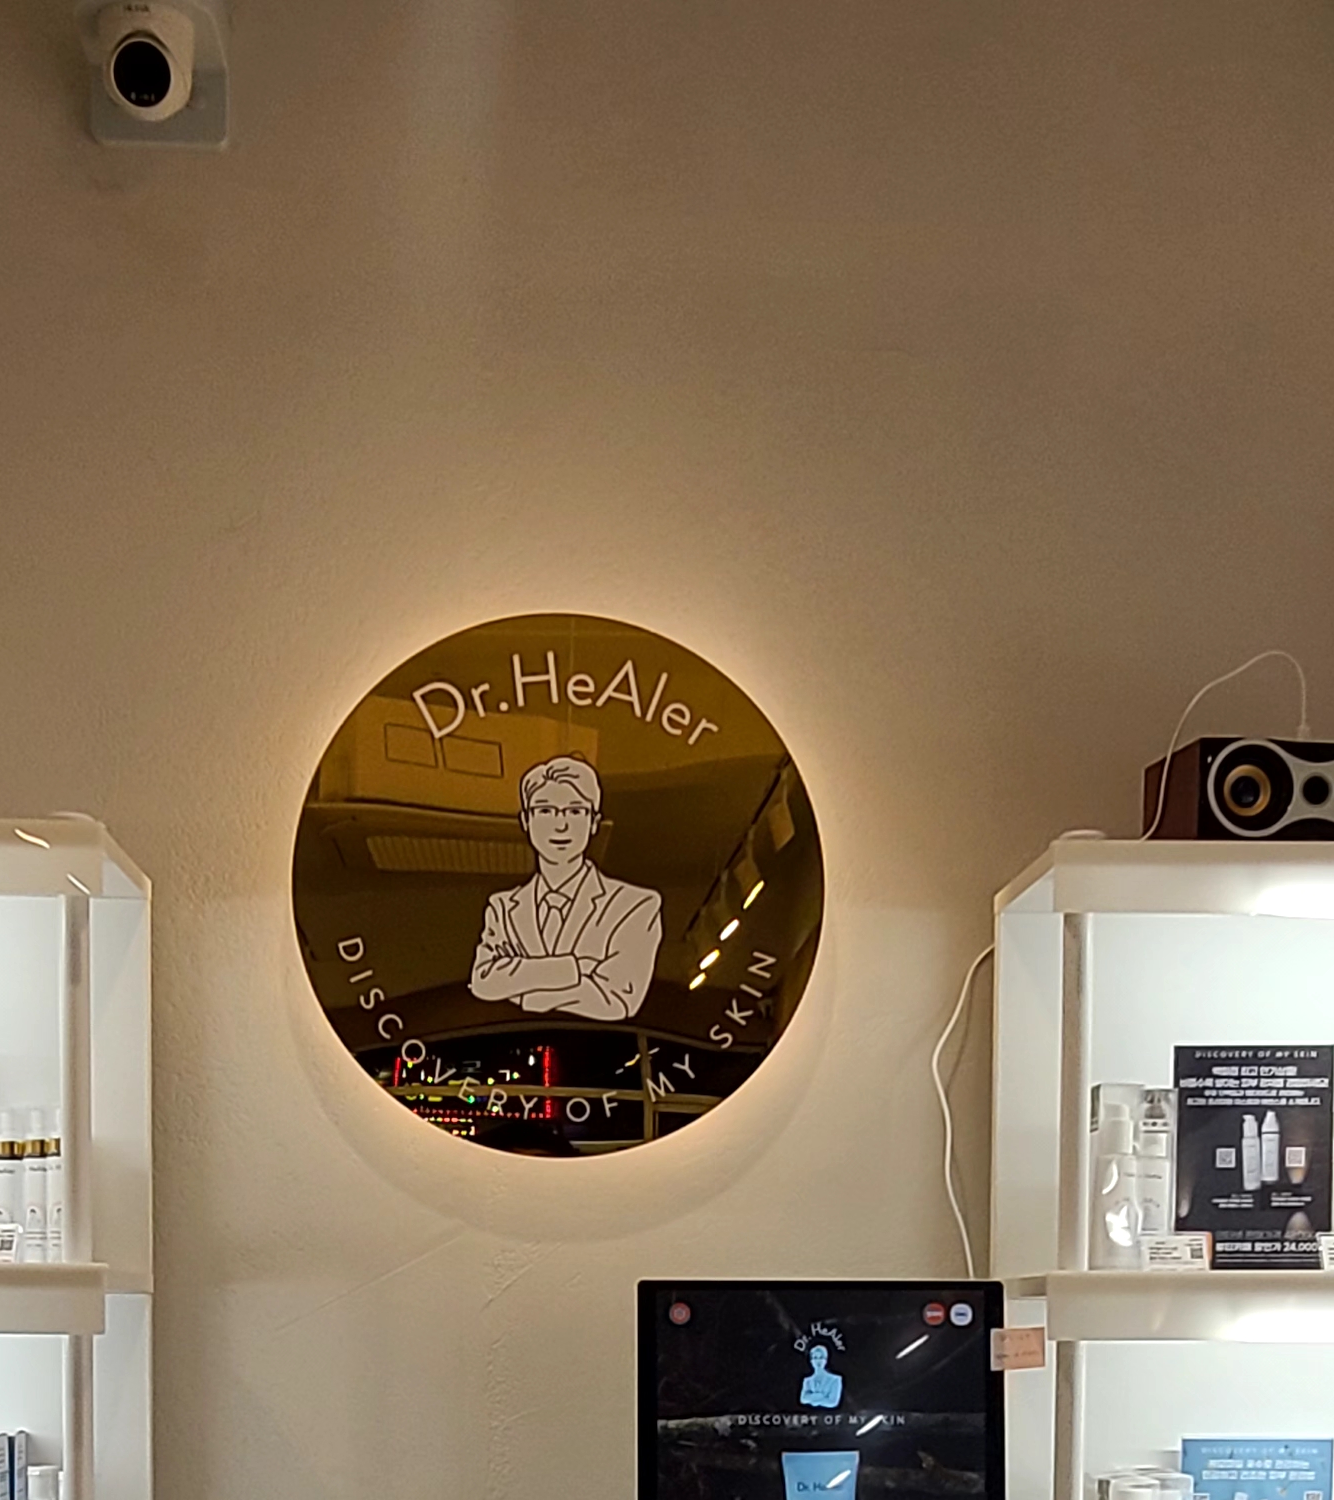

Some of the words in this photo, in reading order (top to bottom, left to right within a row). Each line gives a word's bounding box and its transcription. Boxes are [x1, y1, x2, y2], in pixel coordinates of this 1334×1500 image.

[412, 650, 719, 747] Dr.HeAler
[338, 936, 540, 1121] DISCOVERY
[567, 1091, 618, 1122] OF
[646, 1052, 696, 1102] MY
[710, 950, 777, 1050] SKIN
[738, 1416, 818, 1426] DISCOVERY
[824, 1416, 841, 1426] OF
